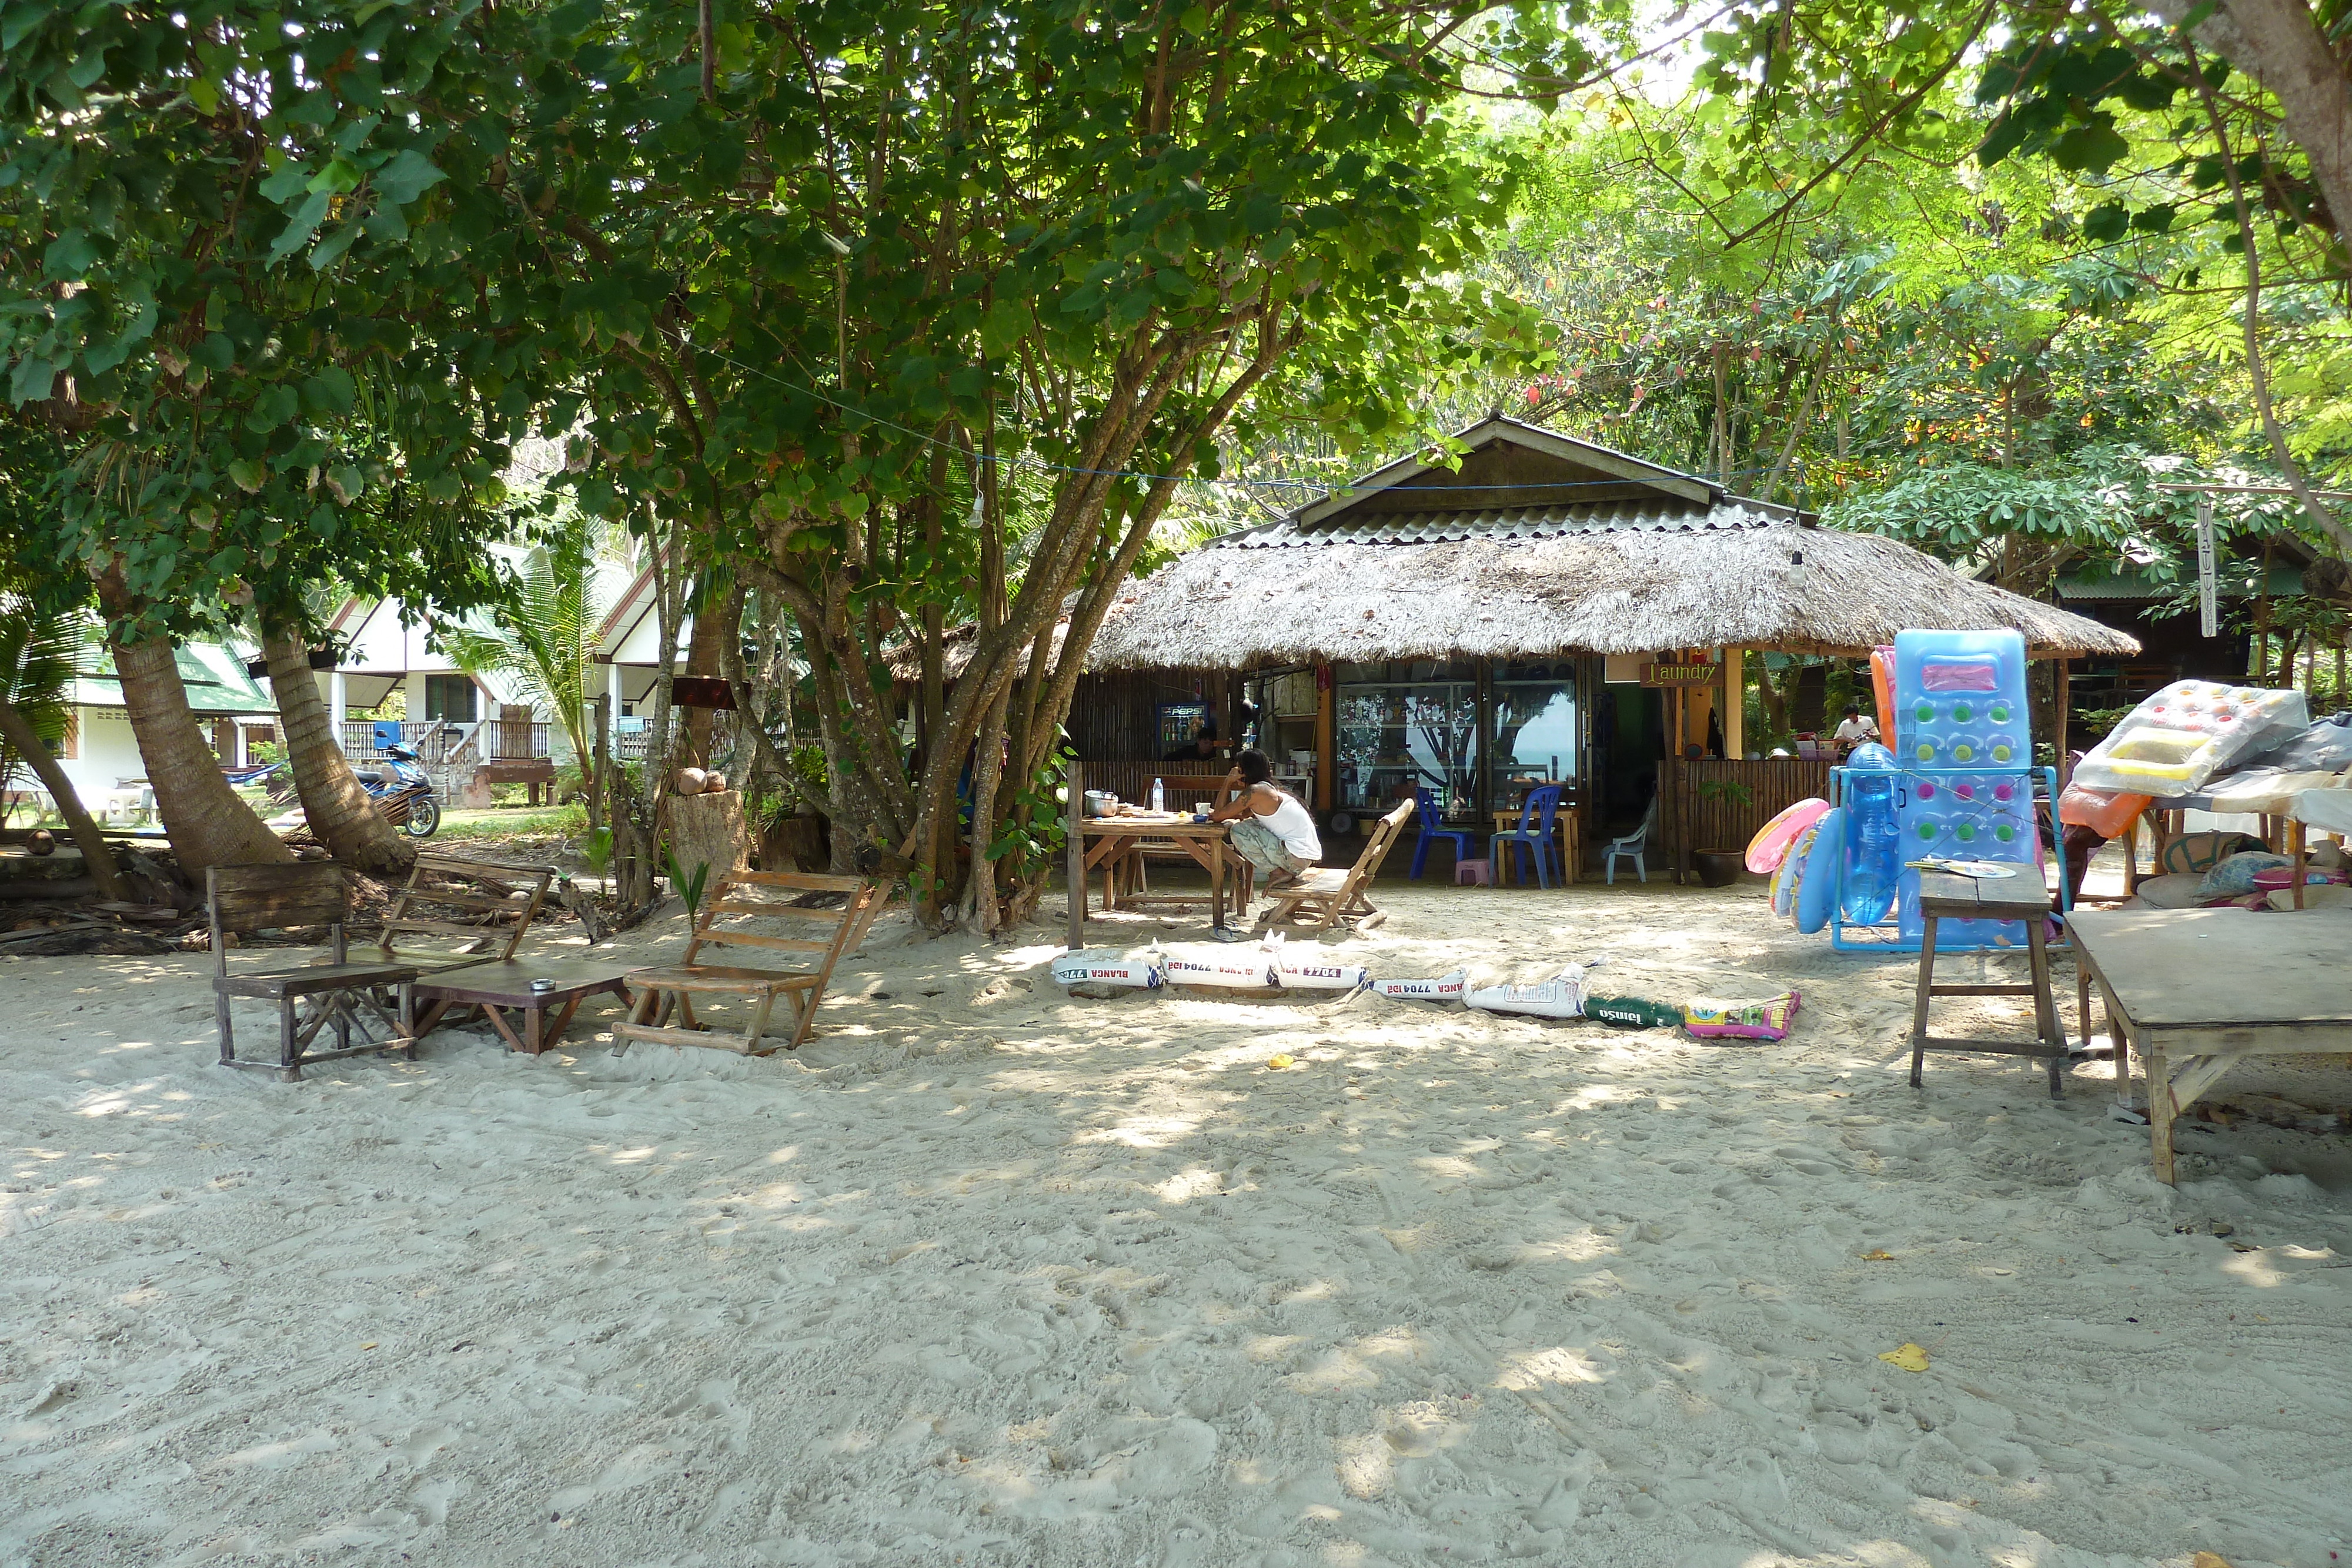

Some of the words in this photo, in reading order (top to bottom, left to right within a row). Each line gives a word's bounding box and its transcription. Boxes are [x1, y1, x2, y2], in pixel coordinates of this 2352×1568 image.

[1646, 663, 1716, 685] Laundry
[1184, 963, 1211, 972] 7704
[1307, 967, 1338, 977] 7704
[1091, 969, 1128, 978] BLANCA
[1404, 985, 1431, 993] 7704
